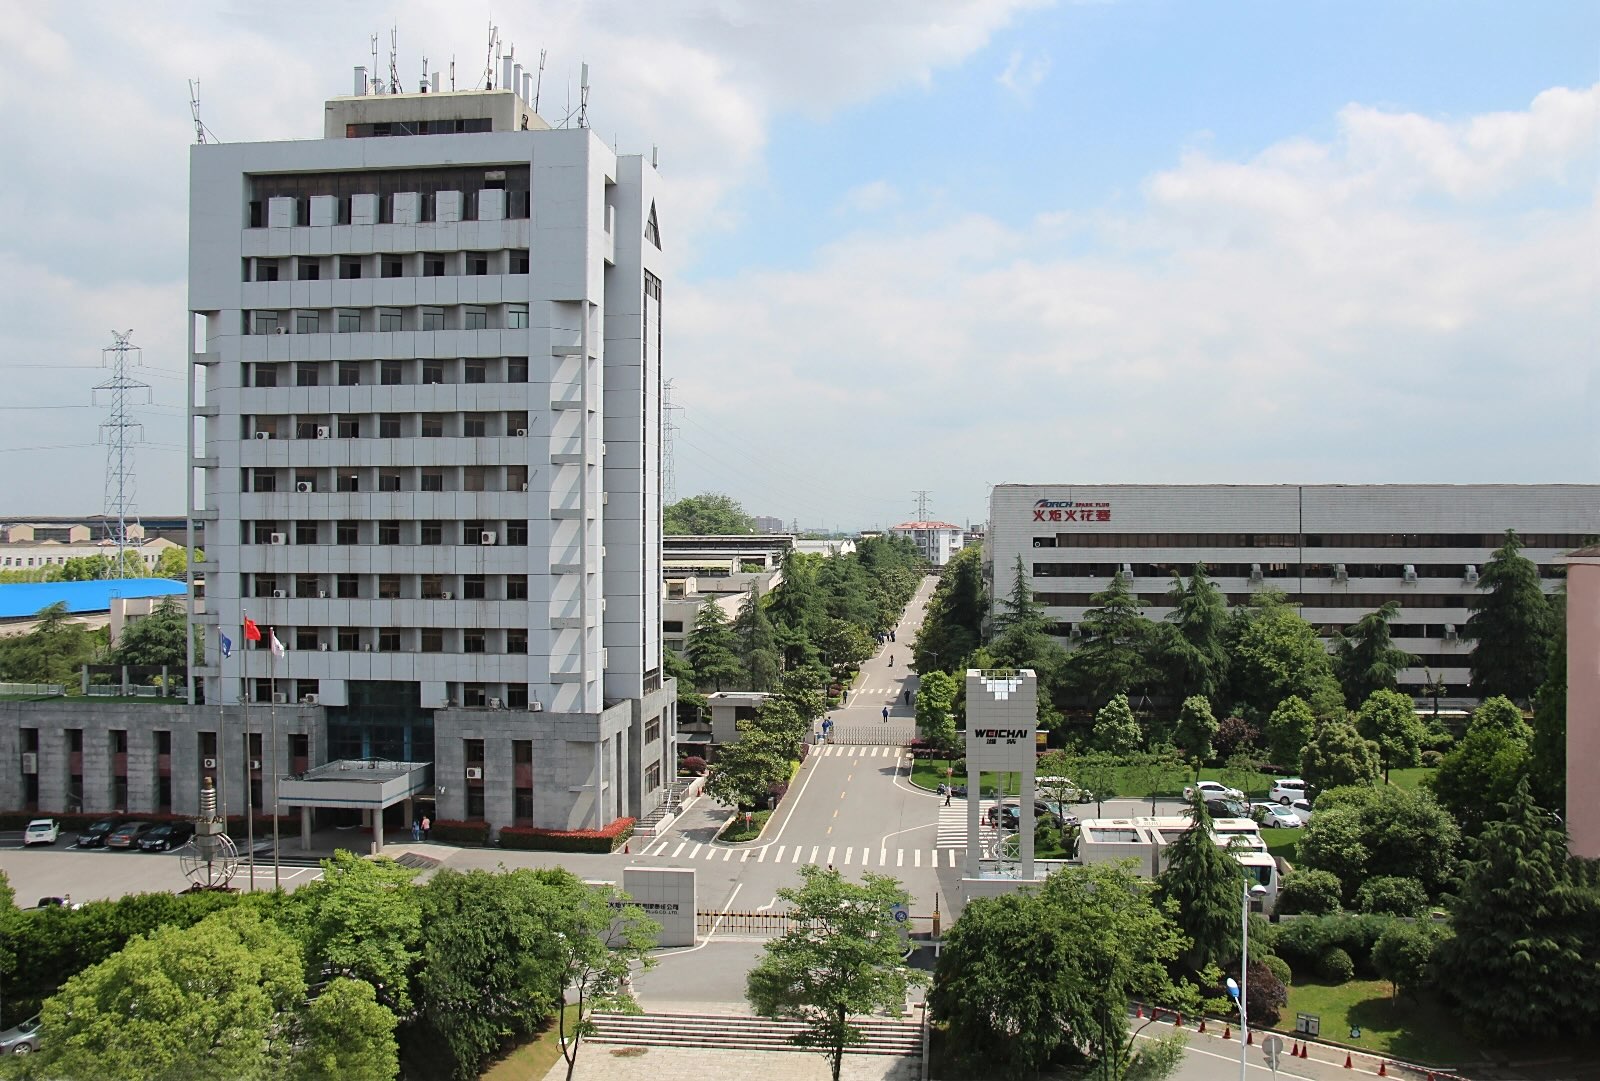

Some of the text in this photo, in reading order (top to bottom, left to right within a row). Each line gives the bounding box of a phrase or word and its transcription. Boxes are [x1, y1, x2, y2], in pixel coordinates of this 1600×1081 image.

[1033, 510, 1110, 522] 火炬火花塞
[975, 729, 1028, 738] WEICHAI
